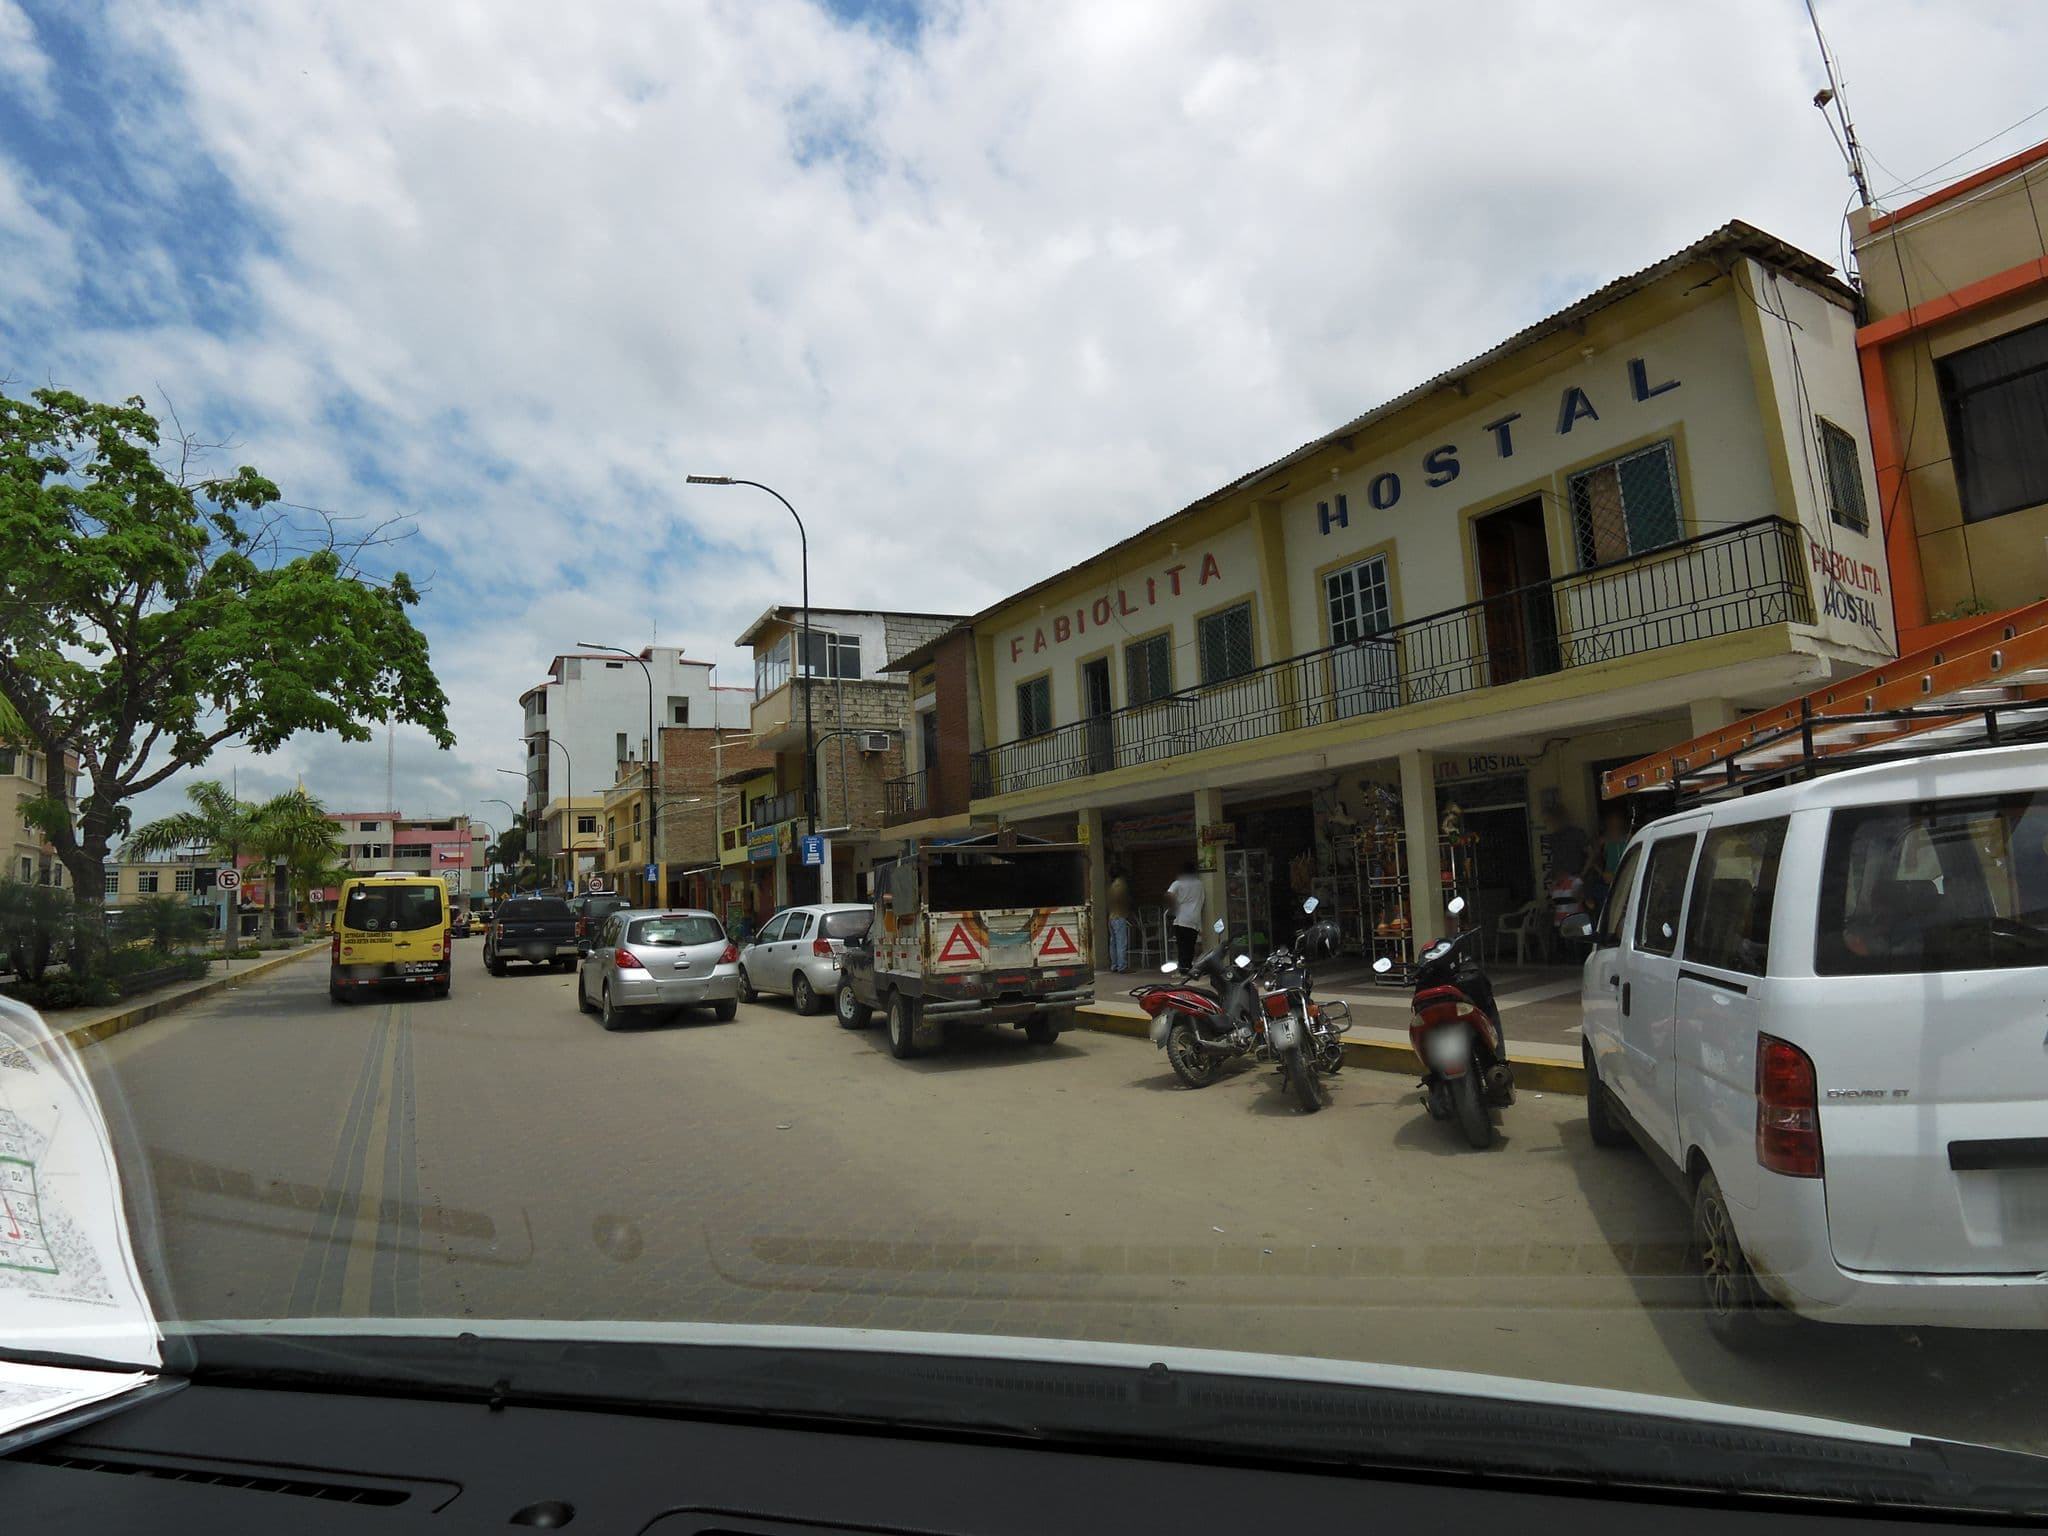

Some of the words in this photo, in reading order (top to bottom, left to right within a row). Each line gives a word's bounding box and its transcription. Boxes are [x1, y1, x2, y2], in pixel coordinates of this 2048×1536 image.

[1317, 357, 1682, 536] HOSTAL
[1810, 543, 1883, 596] FABIOLITA
[1010, 552, 1222, 664] FABIOLITA
[1823, 585, 1882, 631] HOSTAL
[1468, 755, 1525, 774] HOSTAL
[809, 843, 818, 853] E
[224, 873, 235, 885] E
